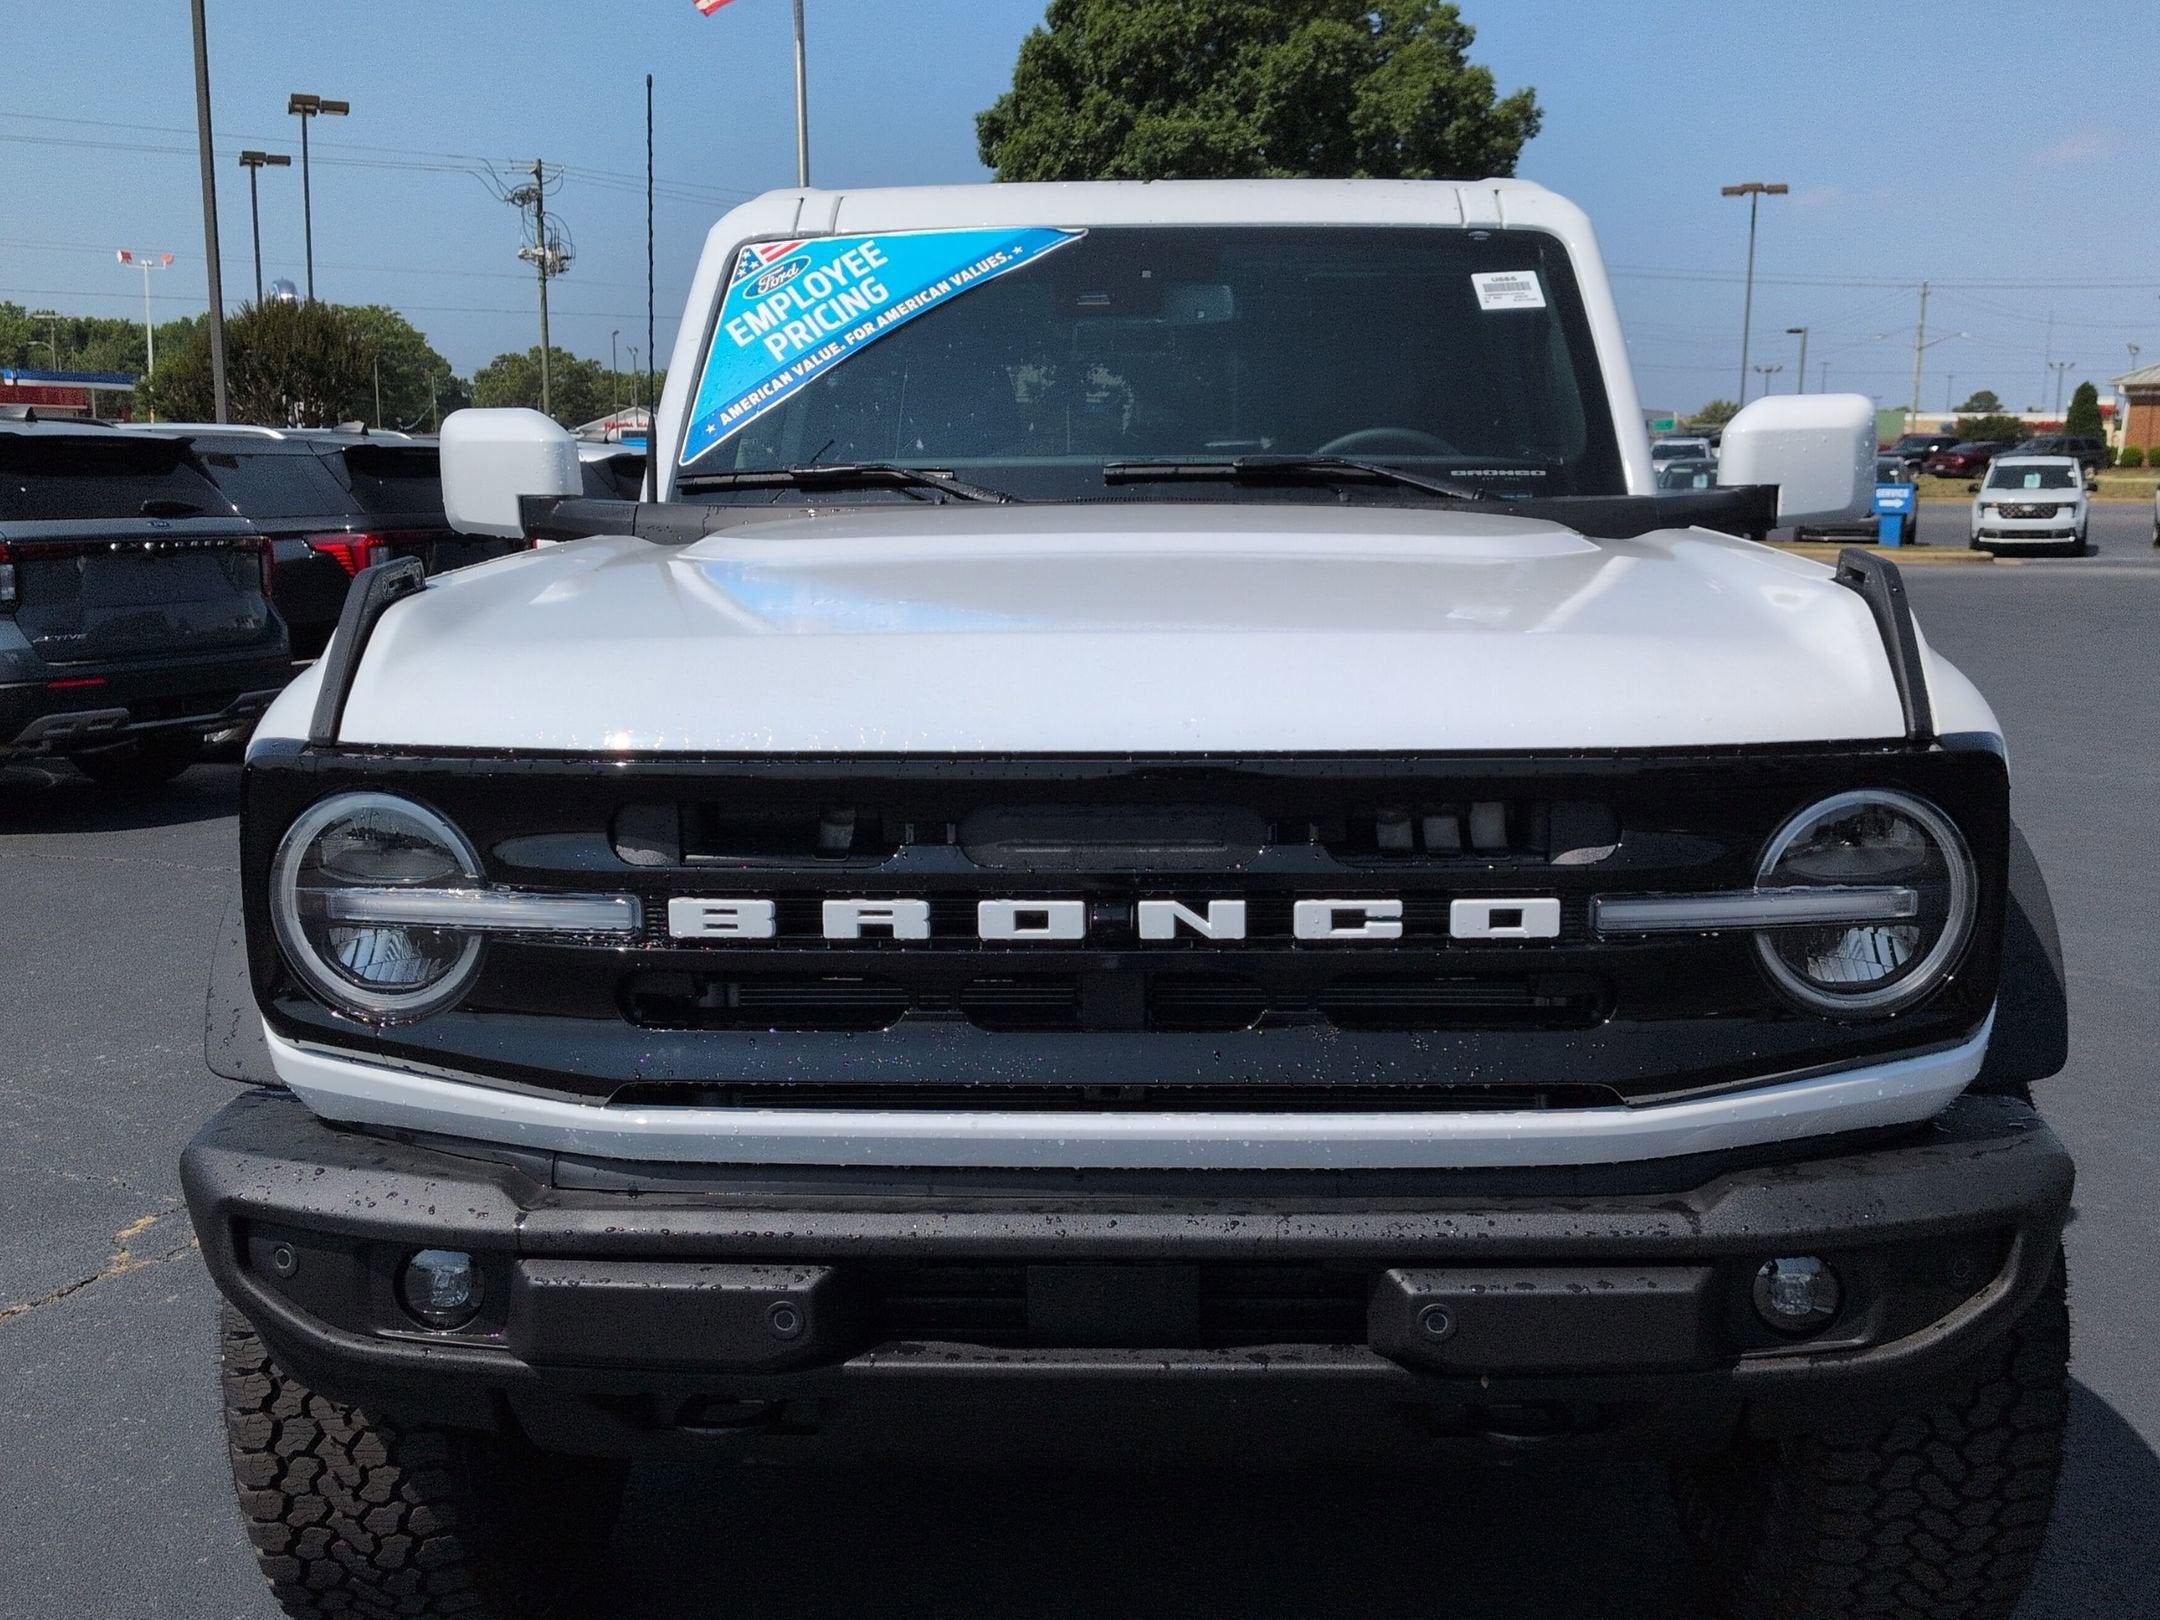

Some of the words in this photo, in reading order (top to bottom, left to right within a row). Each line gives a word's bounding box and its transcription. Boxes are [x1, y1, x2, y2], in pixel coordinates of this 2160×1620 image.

[725, 240, 889, 347] EMPLOYEE
[757, 261, 800, 295] Ford
[763, 276, 889, 362] PRICING
[719, 371, 794, 426] AMERICAN
[791, 341, 846, 377] VALUE.
[844, 321, 877, 345] FOR
[876, 280, 952, 332] AMERICAN
[949, 251, 1013, 286] VALUES.
[668, 898, 1561, 940] BRONCO
